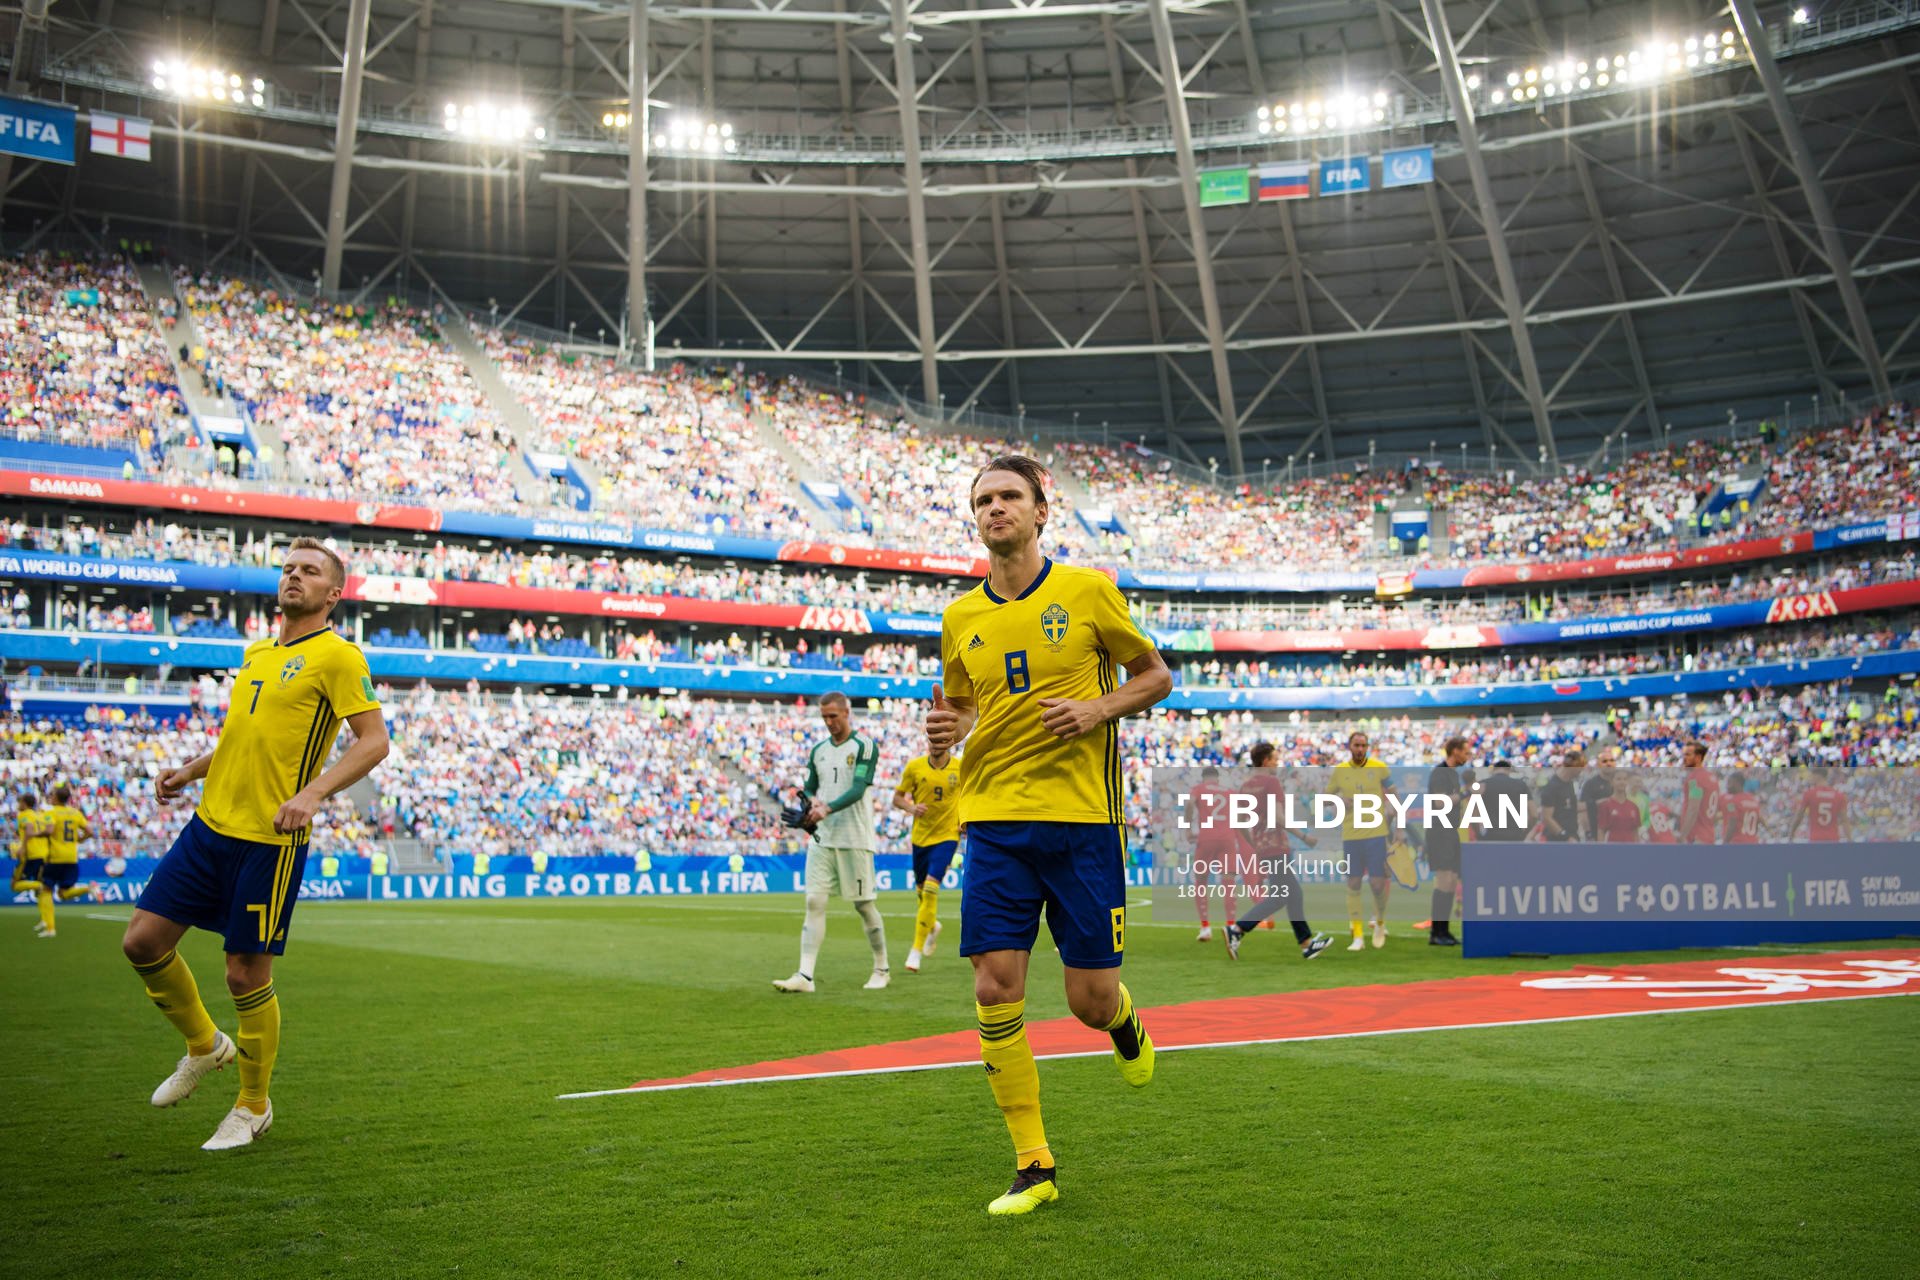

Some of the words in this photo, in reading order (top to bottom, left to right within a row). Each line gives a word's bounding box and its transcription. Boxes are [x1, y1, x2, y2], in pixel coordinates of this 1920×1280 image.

[0, 114, 61, 145] FIFA
[1326, 167, 1362, 184] FIFA
[30, 477, 104, 498] SAMARA
[23, 558, 82, 577] WORLD
[83, 562, 117, 579] CUP
[119, 565, 178, 583] RUSSIA
[1005, 650, 1030, 695] 8
[250, 680, 264, 715] 7
[832, 767, 838, 784] 1
[933, 786, 943, 802] 9
[1742, 811, 1759, 836] 10
[1818, 803, 1832, 826] 5
[63, 820, 74, 842] 6
[382, 874, 506, 898] LIVING
[525, 873, 692, 897] FOOTBALL
[717, 872, 769, 893] FIFA
[857, 879, 862, 897] 1
[1862, 876, 1882, 891] SAY
[1884, 875, 1901, 890] NO
[1476, 885, 1599, 916] LIVING
[1616, 882, 1776, 912] FOOTBALL
[1804, 879, 1851, 907] FIFA
[1862, 892, 1878, 907] TO
[246, 904, 267, 942] 7
[1110, 906, 1125, 953] 8
